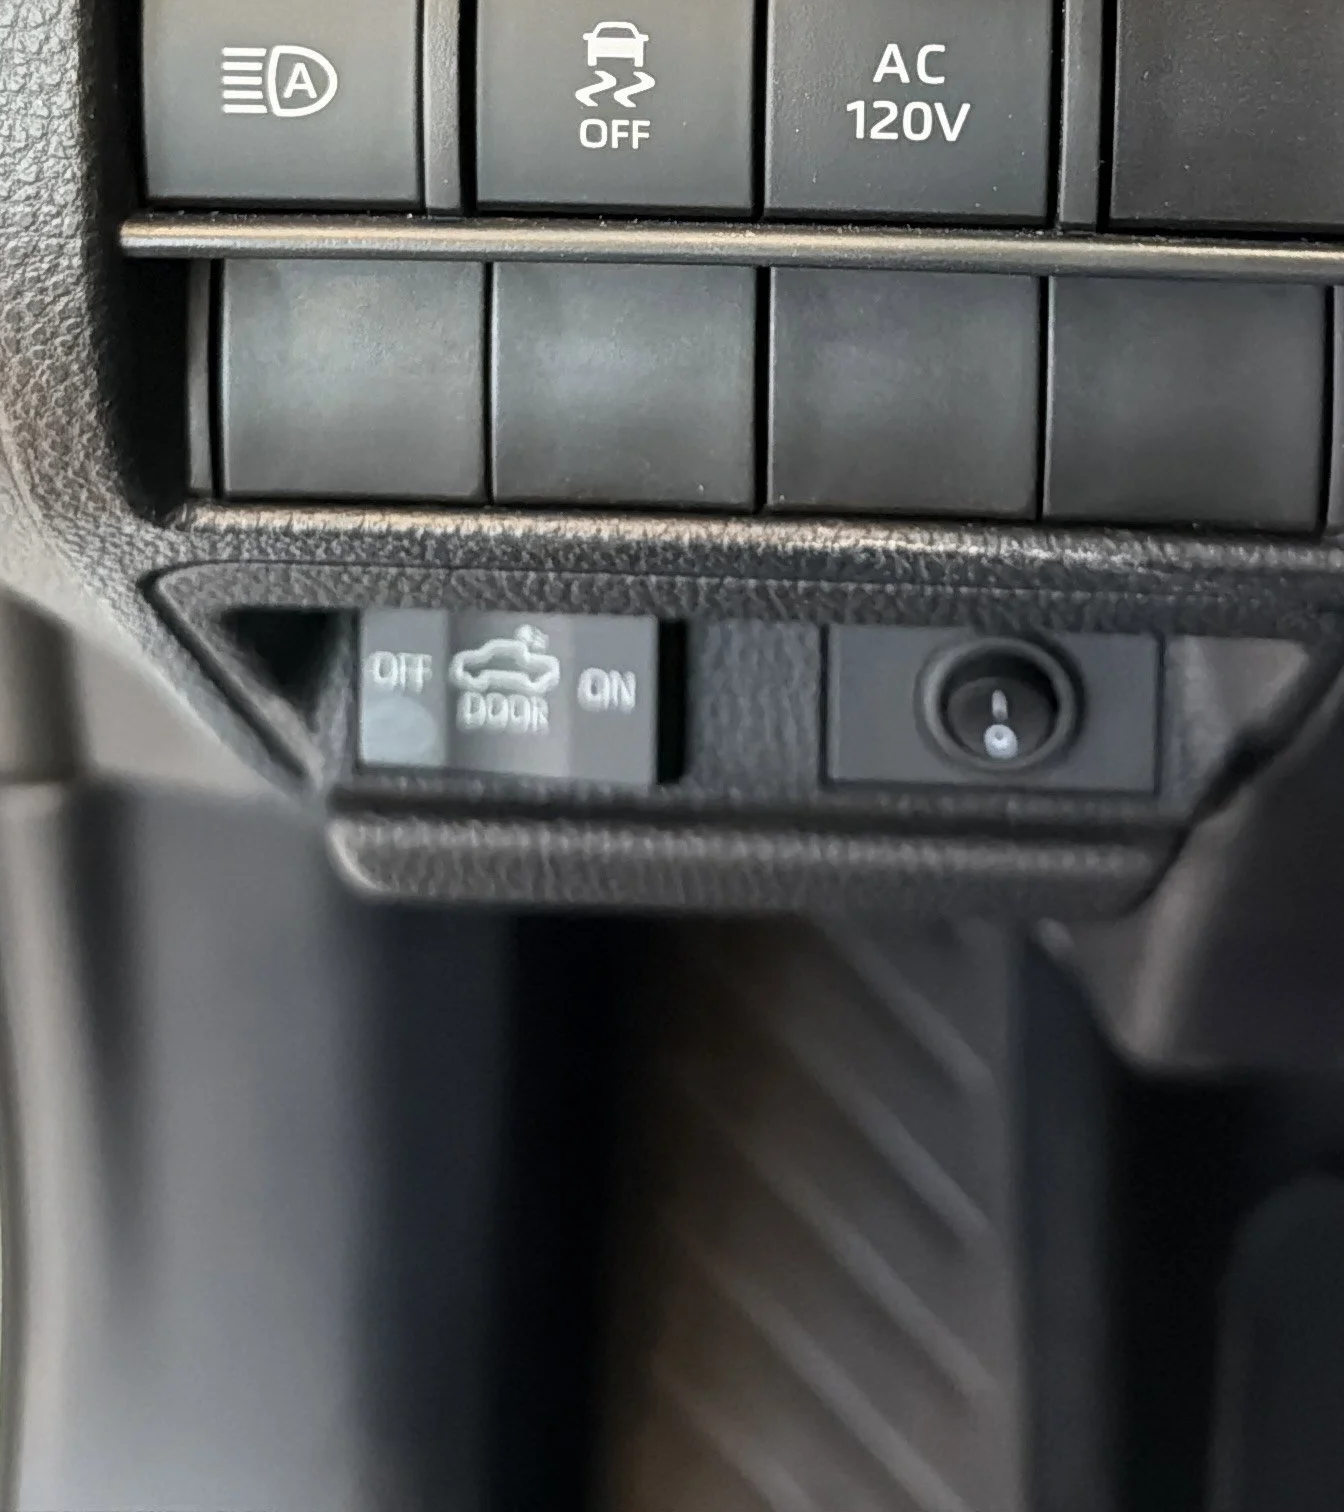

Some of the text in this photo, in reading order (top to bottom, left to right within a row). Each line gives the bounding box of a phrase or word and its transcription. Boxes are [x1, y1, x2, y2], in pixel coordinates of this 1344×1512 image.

[283, 62, 318, 99] A
[872, 43, 947, 85] AC
[578, 118, 652, 150] OFF
[846, 100, 971, 142] 120V
[366, 650, 433, 694] OFF
[576, 666, 636, 713] ON
[457, 691, 549, 734] DOOR
